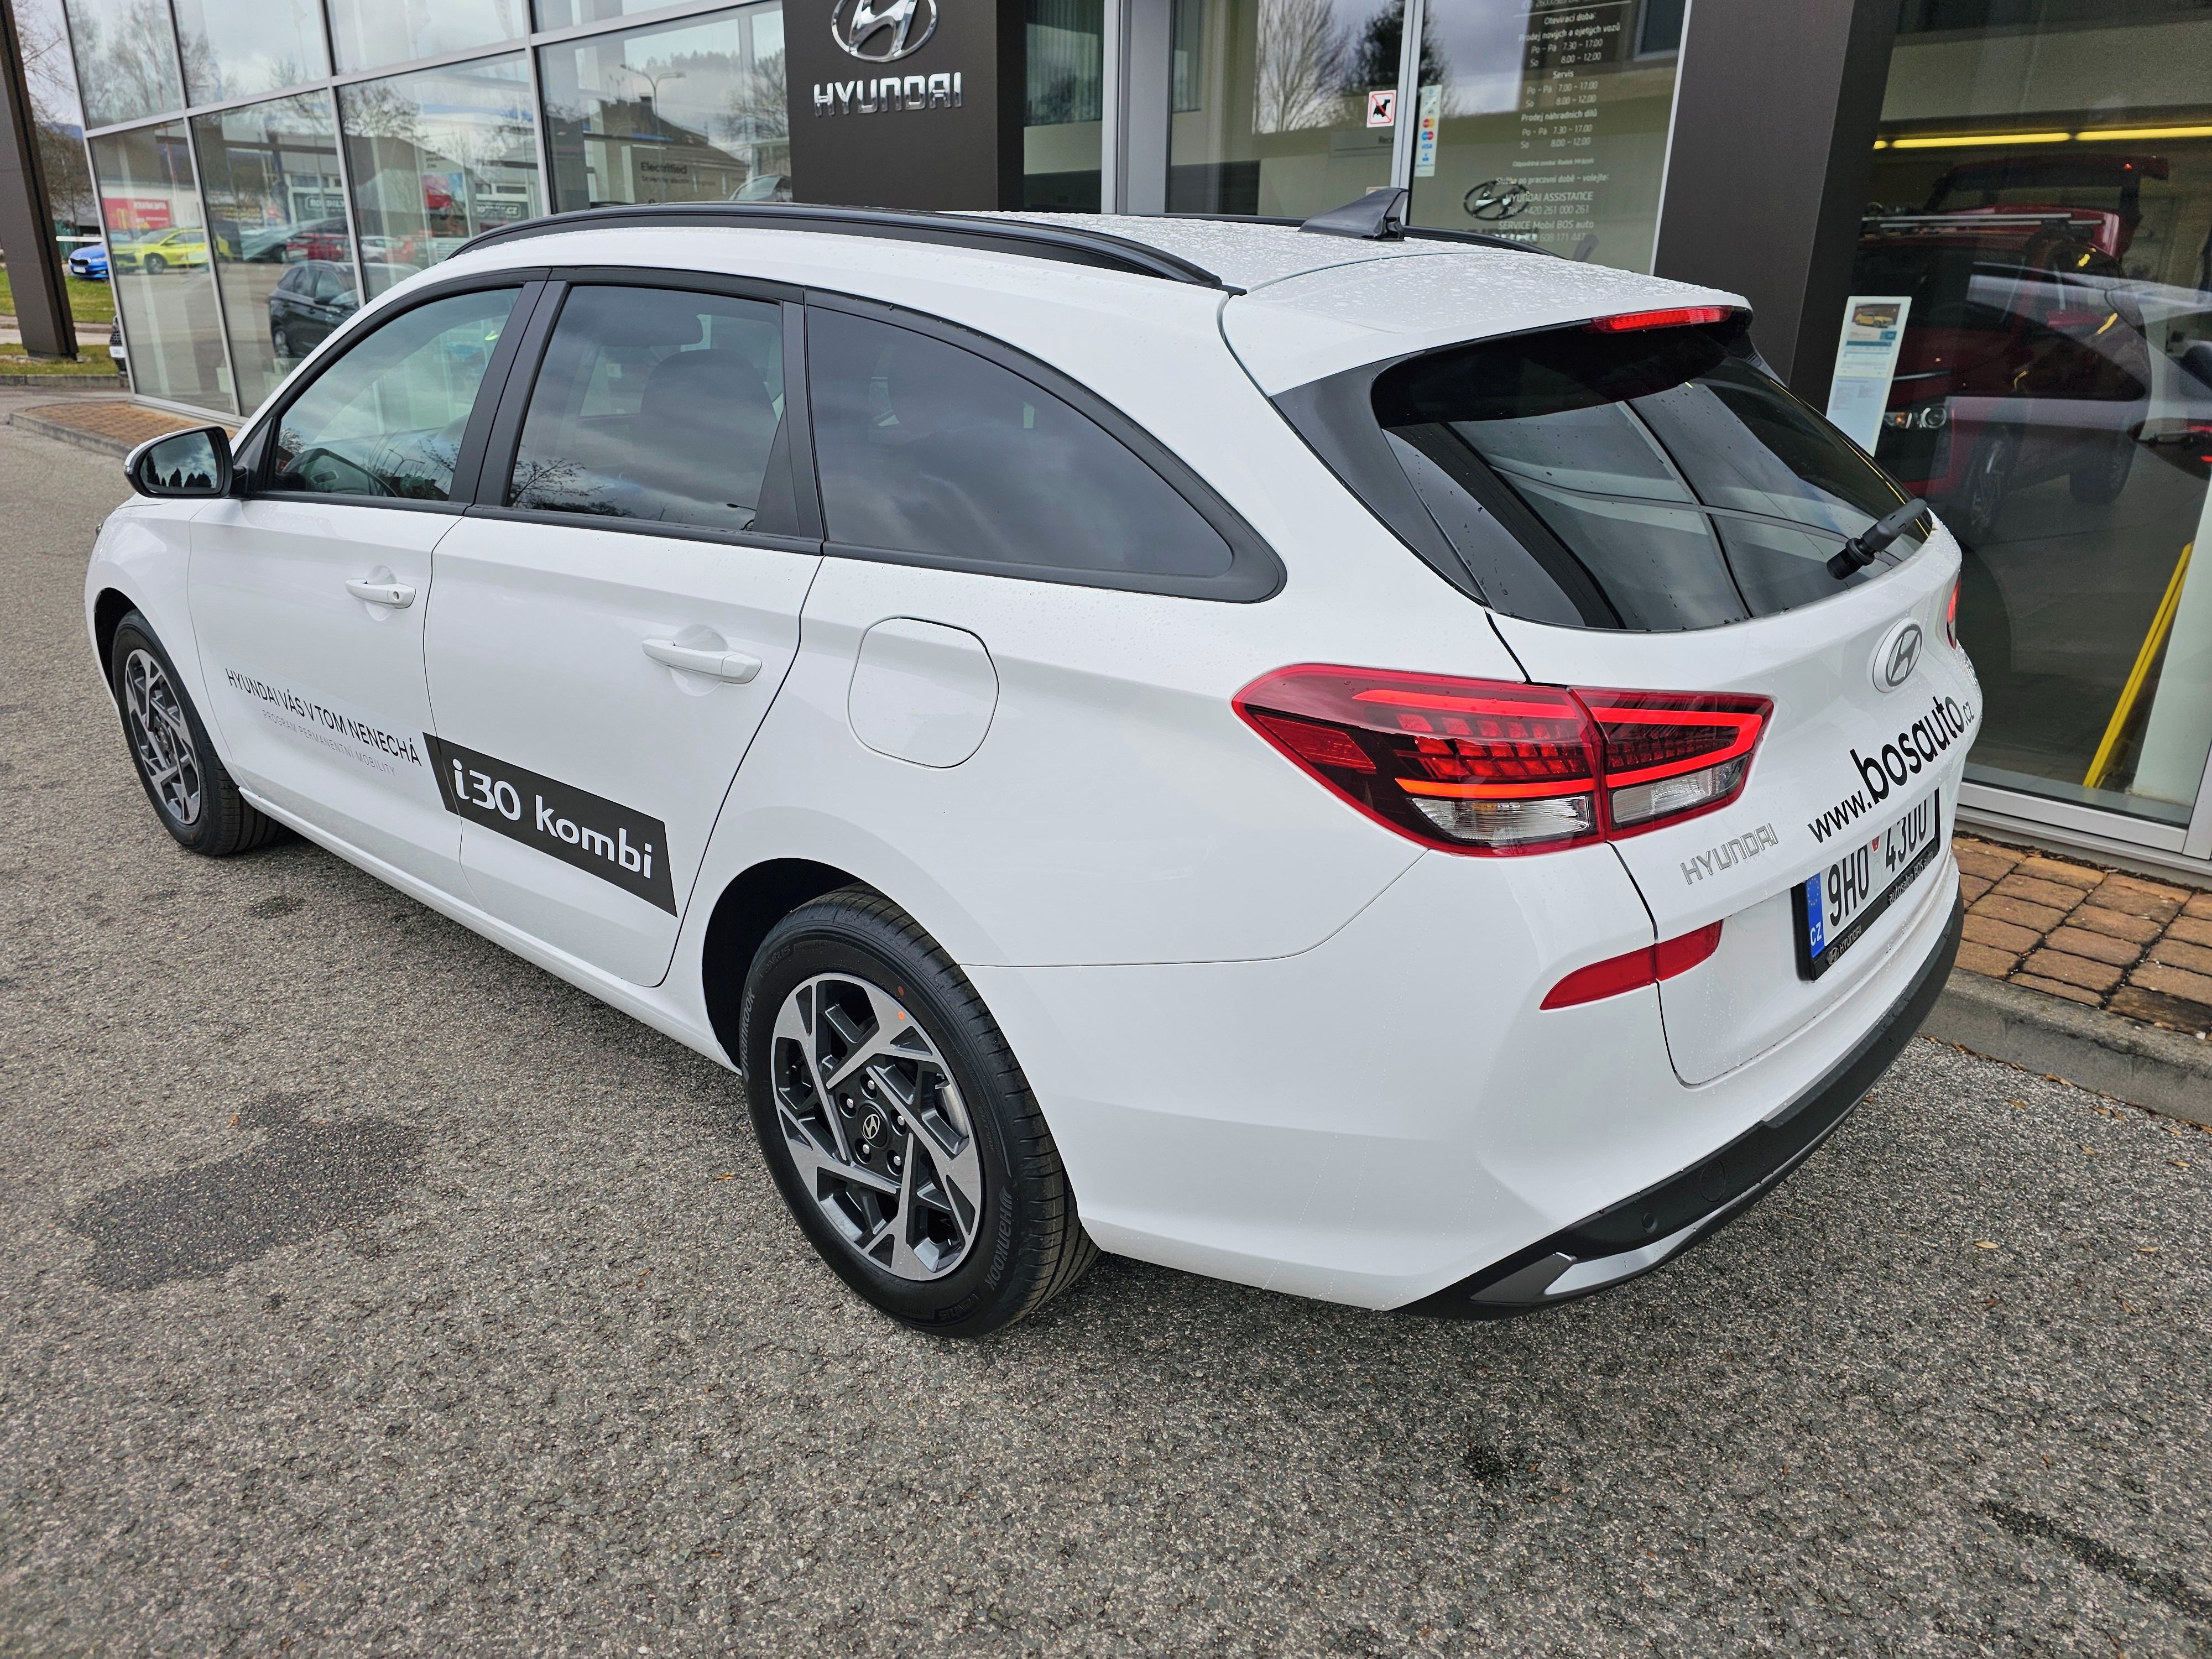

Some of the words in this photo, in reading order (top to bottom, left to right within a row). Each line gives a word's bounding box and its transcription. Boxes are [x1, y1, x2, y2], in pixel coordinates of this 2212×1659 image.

[1585, 38, 1603, 48] 17.00
[1561, 55, 1575, 64] 8.00
[1584, 52, 1601, 61] 12.00
[1552, 70, 1574, 80] Servis
[1558, 83, 1572, 92] 7.00
[1580, 81, 1598, 90] 17.00
[813, 72, 963, 117] HYUNDAI
[1525, 100, 1535, 108] So
[1556, 96, 1571, 106] 8.00
[1578, 95, 1597, 103] 12.00
[1521, 112, 1544, 122] Prodej
[1553, 126, 1567, 134] 7.30
[1575, 123, 1593, 133] 17.00
[1521, 140, 1530, 149] So
[1551, 138, 1566, 148] 8.00
[1573, 137, 1591, 146] 12.00
[640, 161, 687, 174] Electrified
[1505, 193, 1542, 203] HYUNDAI
[1543, 191, 1594, 202] ASSISTANCE
[1543, 205, 1557, 214] 261
[1559, 205, 1574, 214] 000
[1575, 205, 1589, 213] 261
[1498, 221, 1531, 230] SERVICE
[1532, 221, 1554, 229] Mobil
[1556, 220, 1573, 229] BOS
[1575, 220, 1594, 228] auto
[226, 668, 280, 707] HYUNDAI
[278, 688, 305, 717] VÁS
[304, 700, 315, 721] V
[314, 705, 347, 735] TOM
[347, 718, 422, 767] NENECHÁ
[298, 725, 354, 759] PERMANENTNÍ
[355, 751, 395, 777] MOBILITY
[1807, 696, 1975, 843] www.bosauto.cz
[452, 758, 521, 822] i30
[535, 795, 653, 879] kombi
[1680, 823, 1779, 885] HYUNDAI
[1839, 924, 1862, 954] HYUNDAI
[1888, 873, 1914, 905] autosalon
[1914, 859, 1924, 879] BOS
[1810, 921, 1822, 946] CZ
